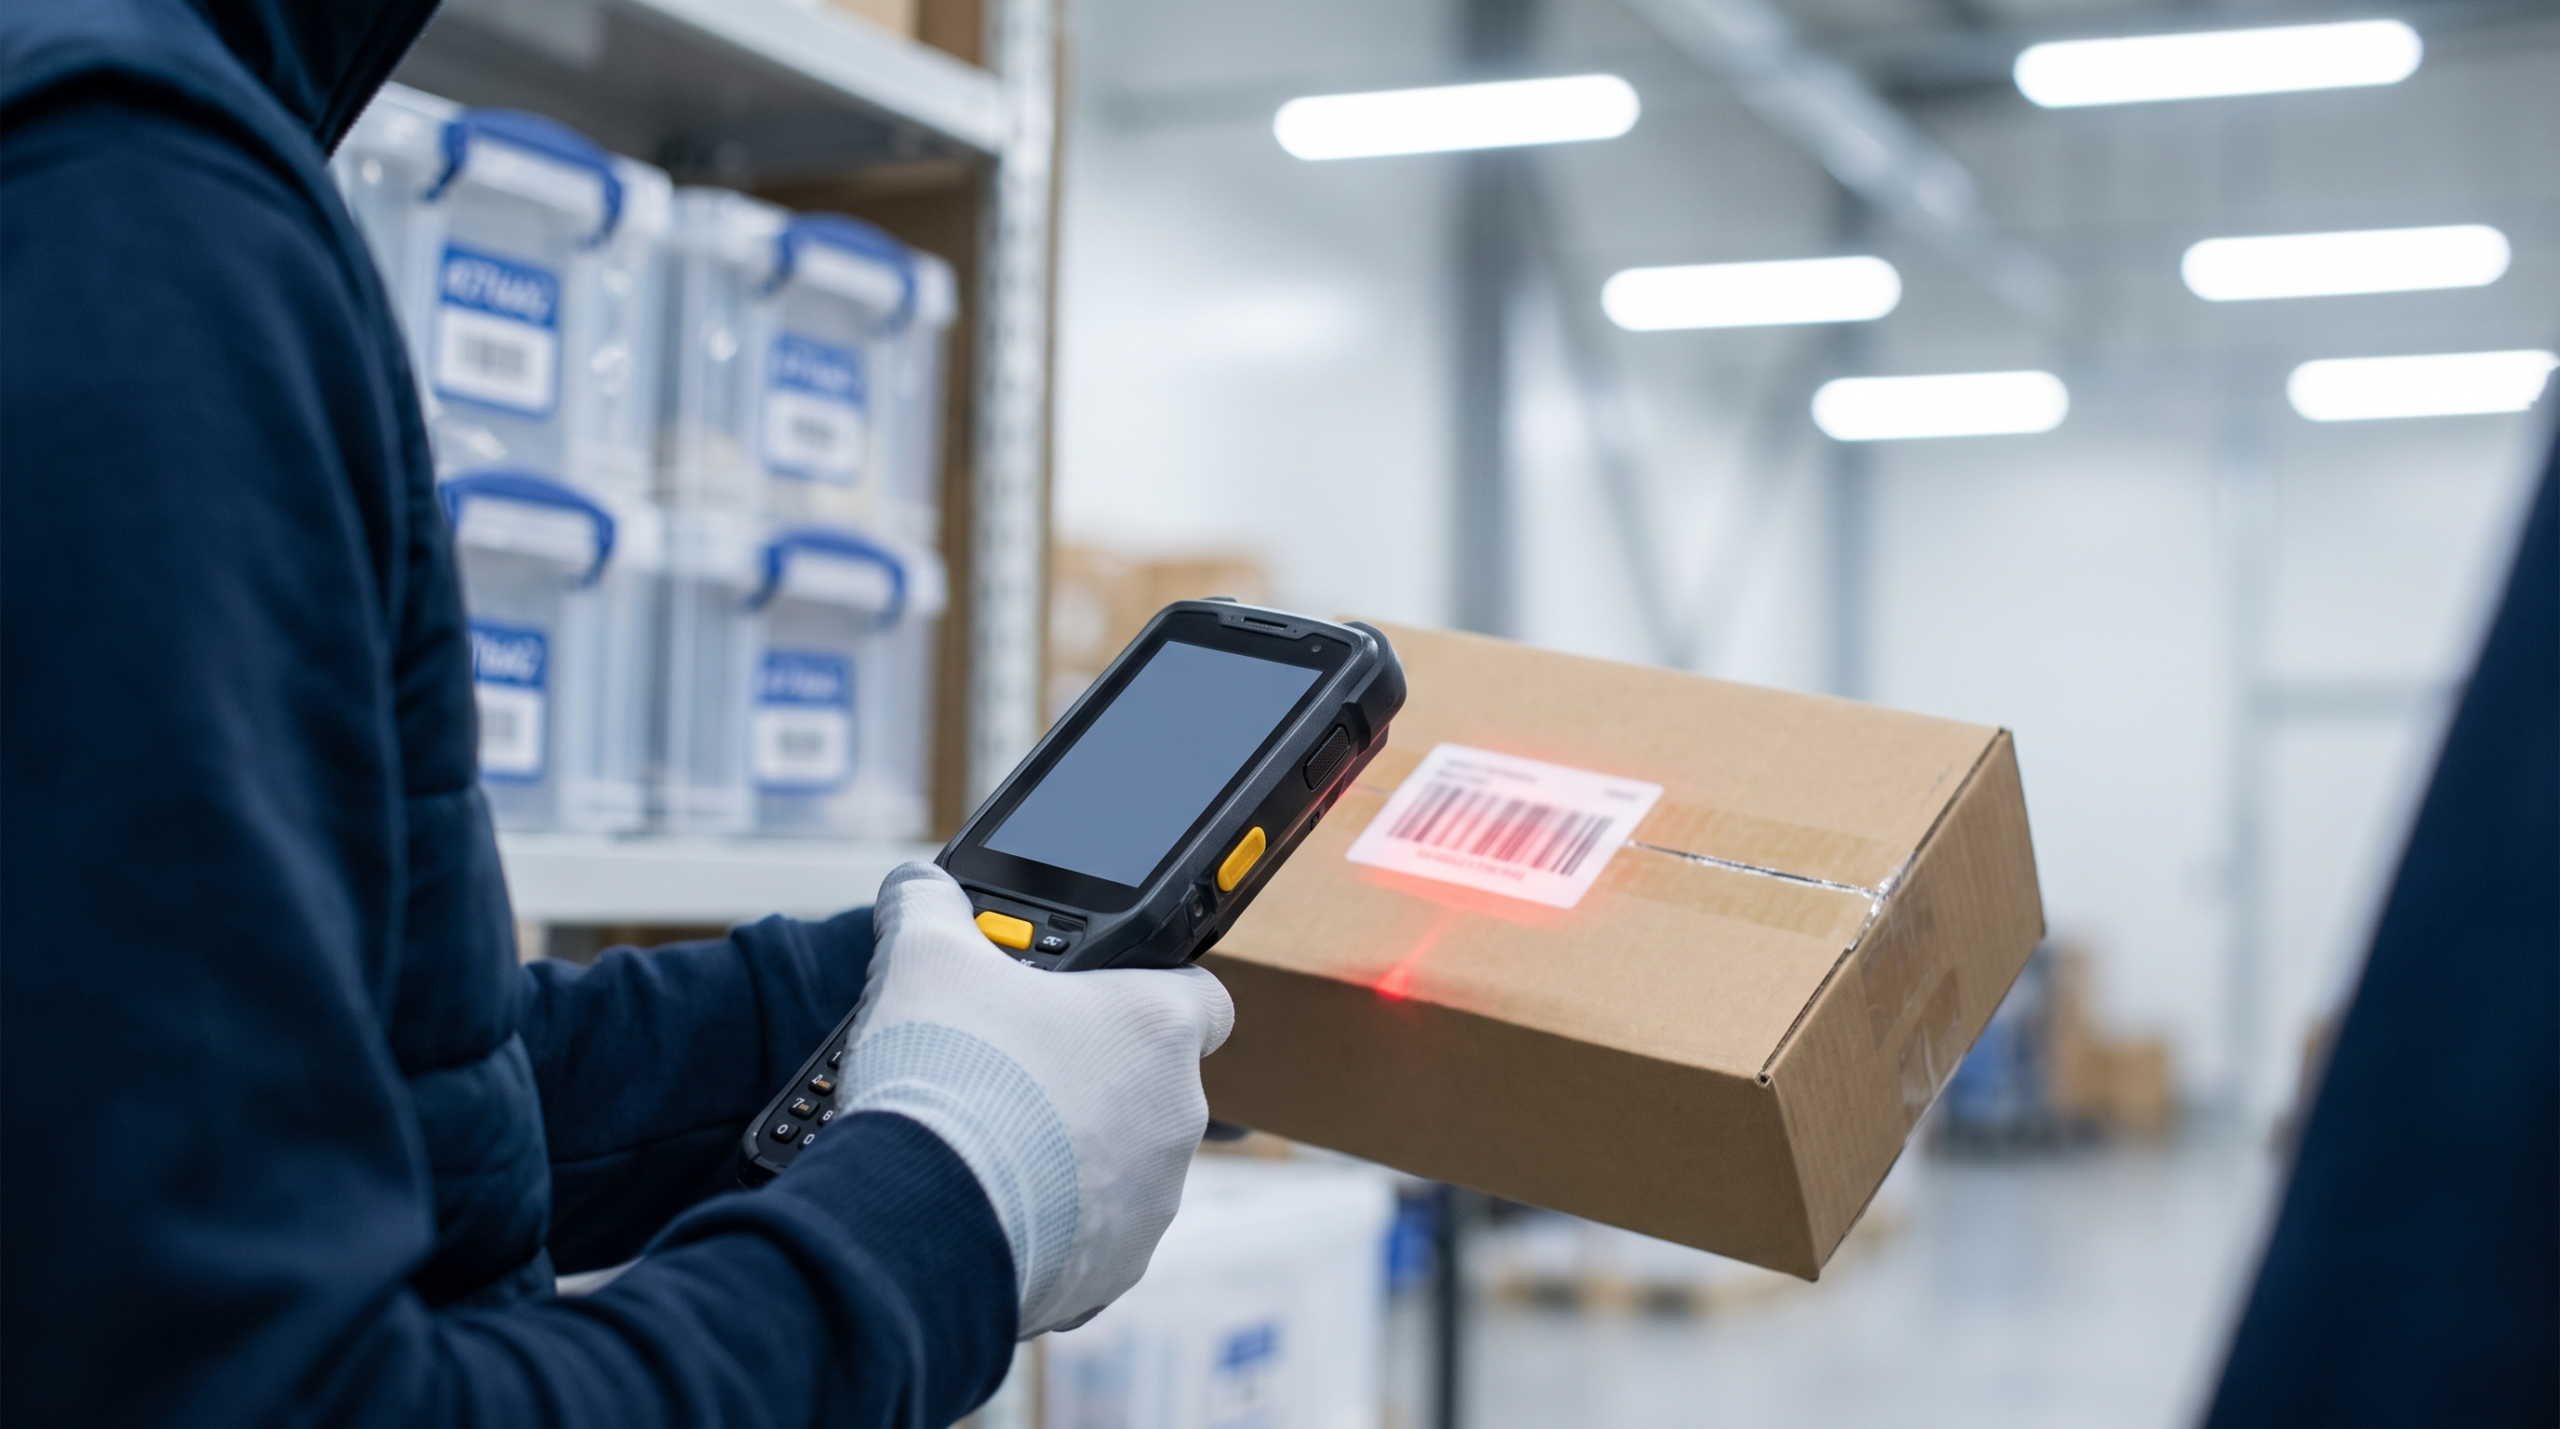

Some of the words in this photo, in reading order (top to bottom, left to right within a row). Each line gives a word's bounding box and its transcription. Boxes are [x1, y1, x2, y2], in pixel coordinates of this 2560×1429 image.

[832, 1051, 841, 1061] 1
[793, 1097, 805, 1108] 7
[822, 1110, 833, 1120] 8
